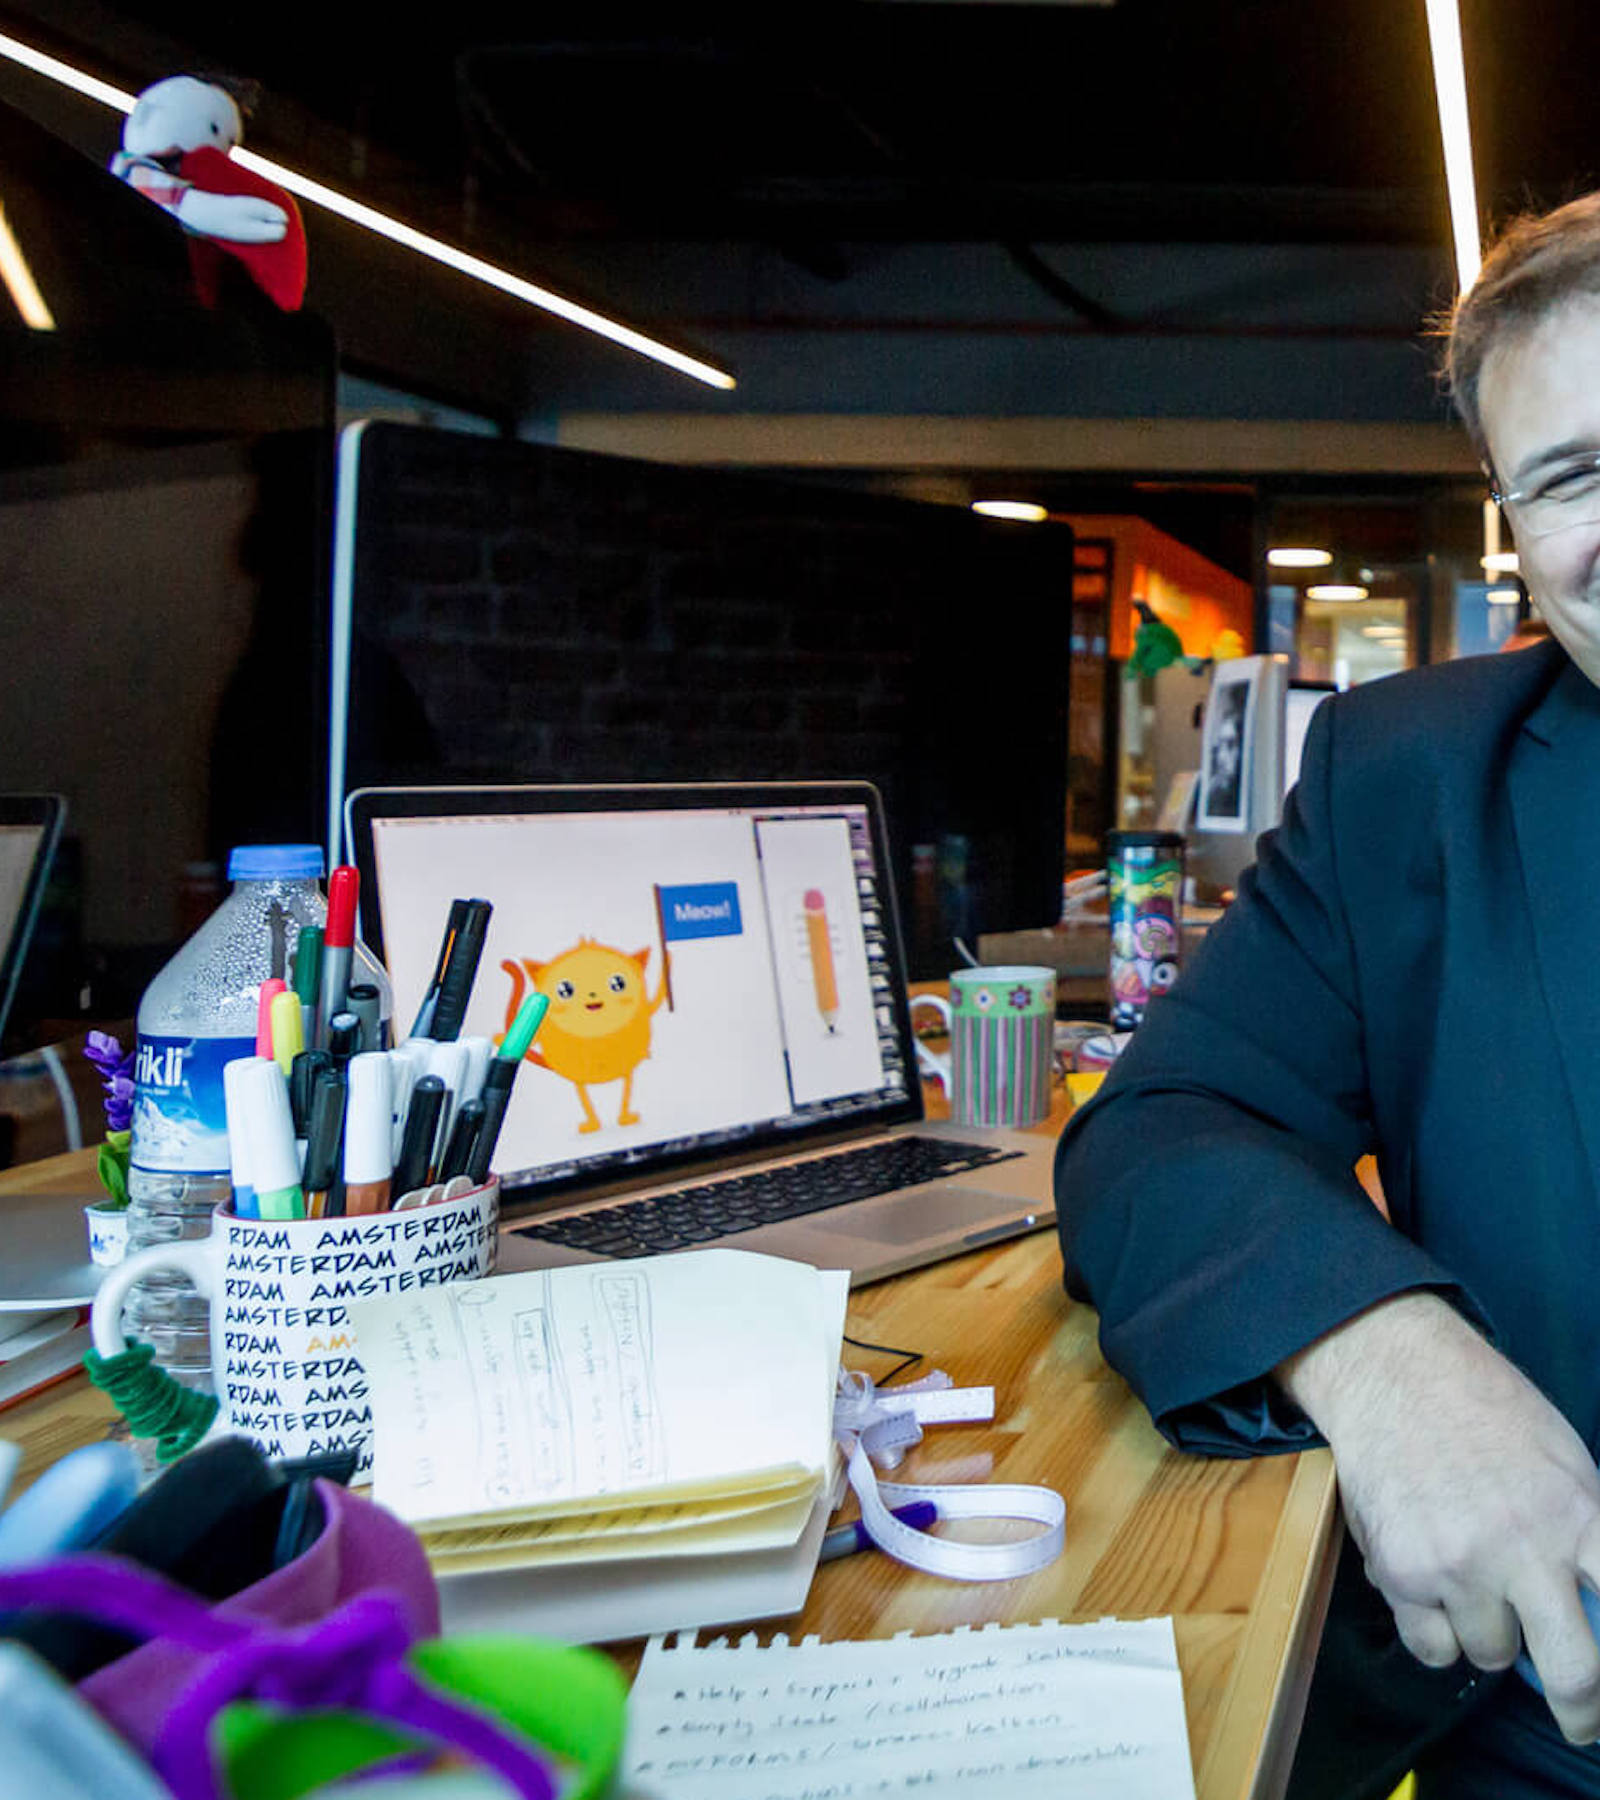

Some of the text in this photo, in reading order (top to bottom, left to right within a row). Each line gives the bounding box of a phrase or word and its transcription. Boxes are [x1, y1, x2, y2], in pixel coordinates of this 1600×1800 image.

[673, 899, 731, 921] Meow!
[229, 1226, 291, 1250] RDAM
[316, 1205, 483, 1250] AMSTERDAM
[226, 1249, 396, 1275] AMSTERDAM
[225, 1278, 285, 1302] RDAM
[310, 1253, 480, 1301] AMSTERDAM
[224, 1306, 351, 1328] AMSTERD
[225, 1332, 358, 1355] RDAM AM
[227, 1379, 369, 1407] RDAM AMS
